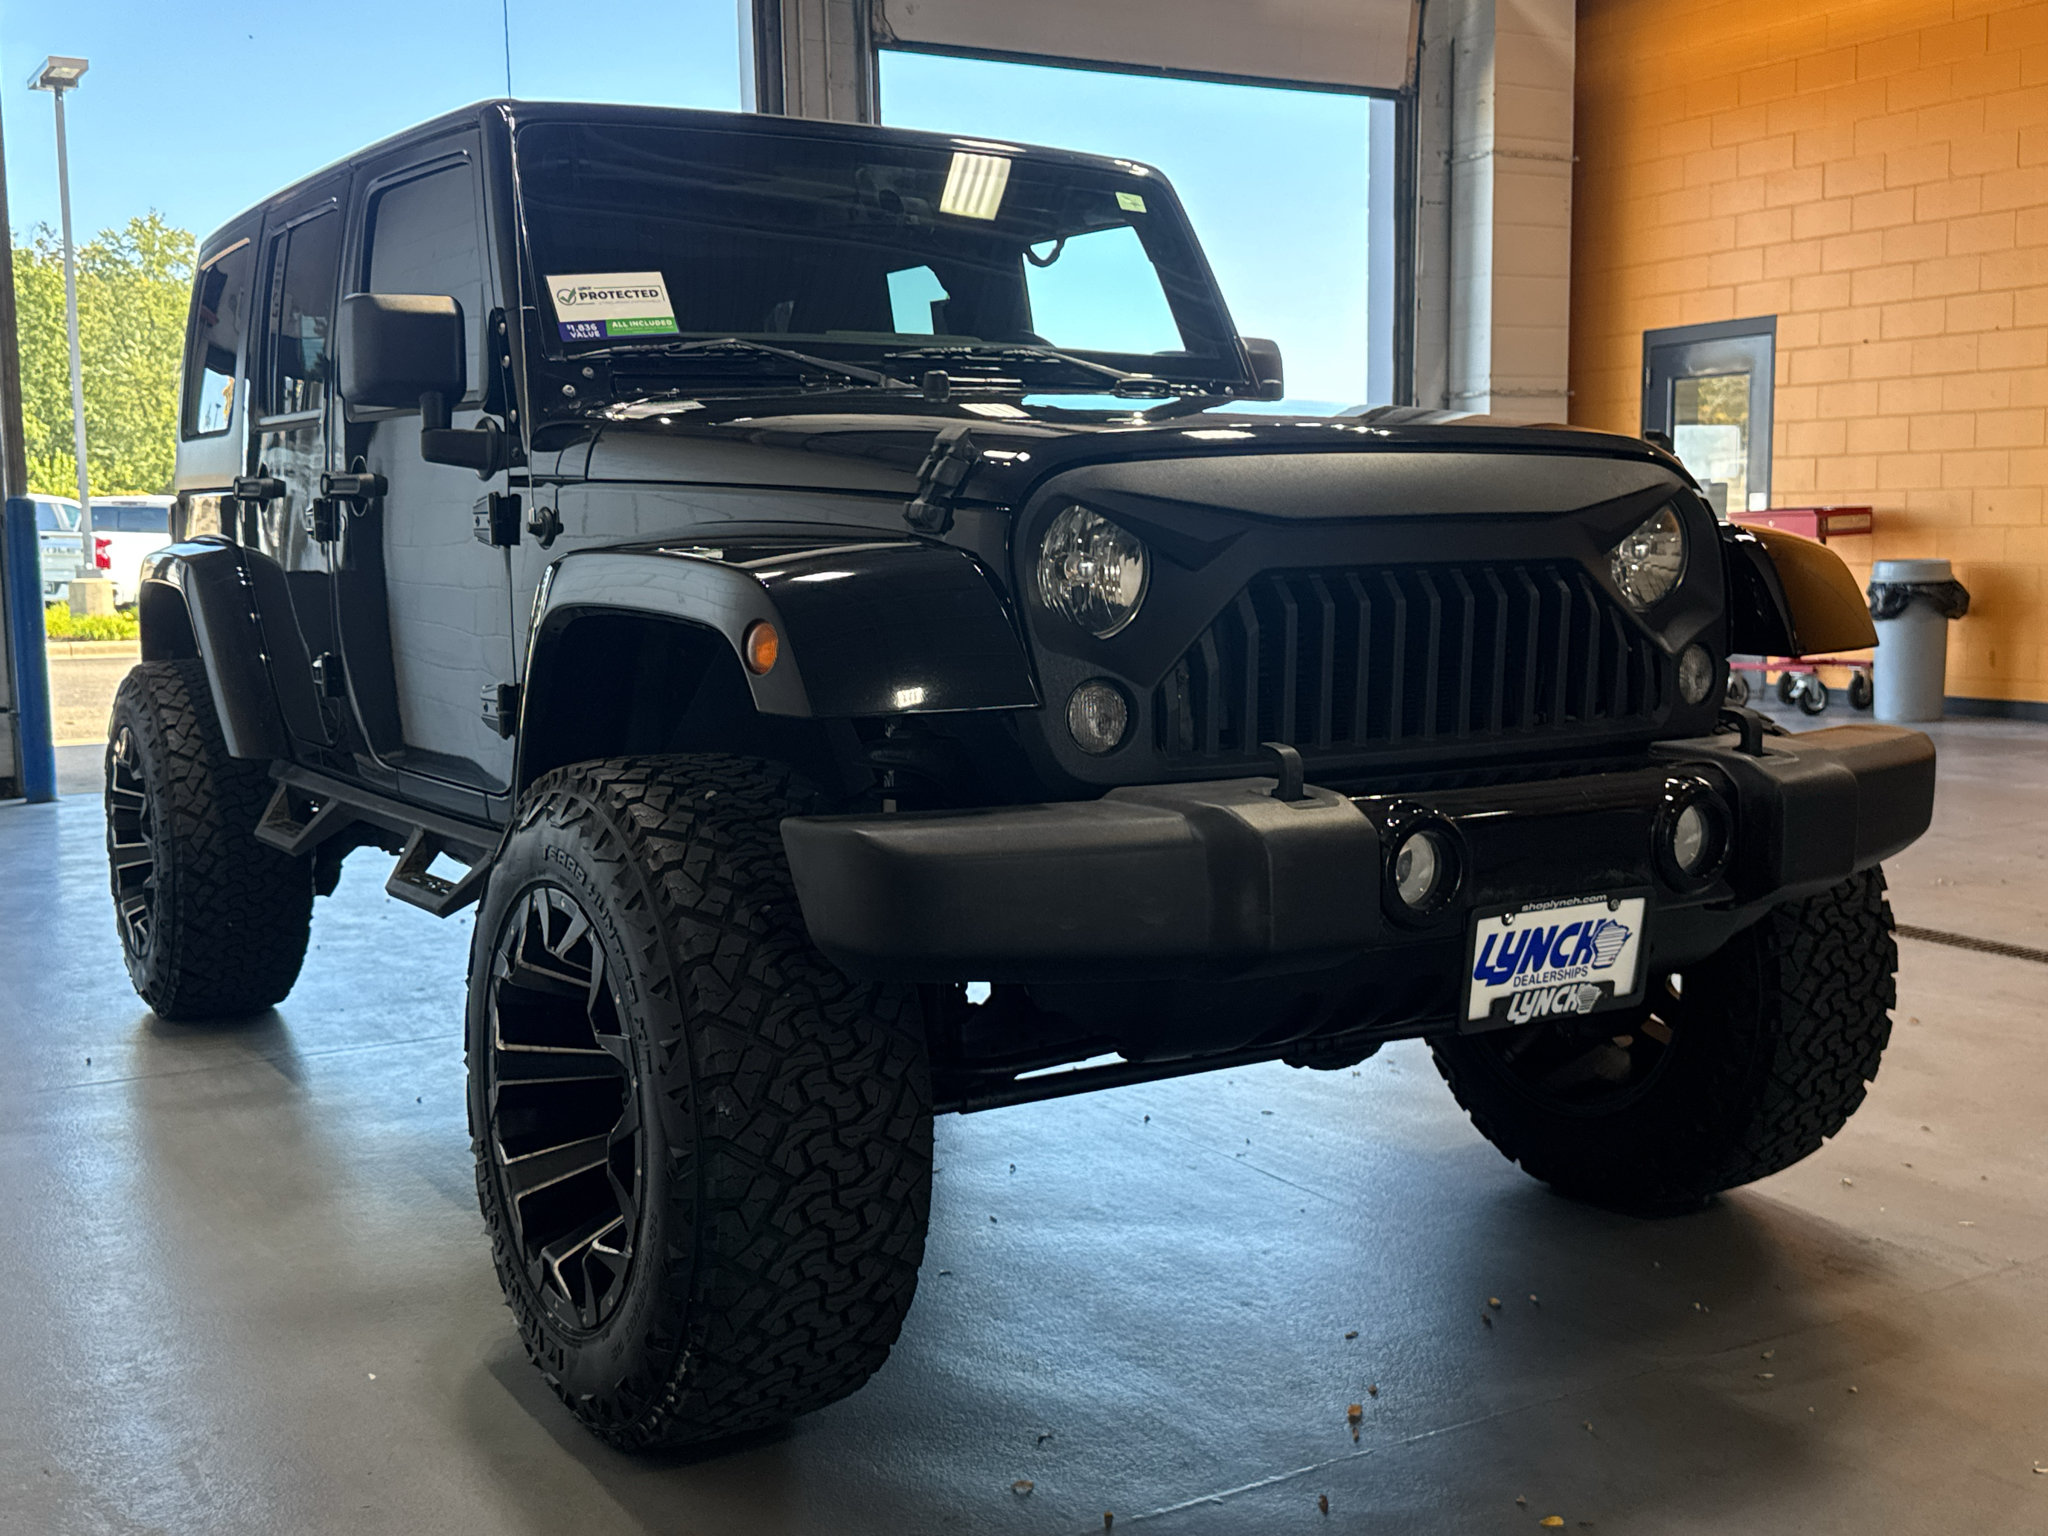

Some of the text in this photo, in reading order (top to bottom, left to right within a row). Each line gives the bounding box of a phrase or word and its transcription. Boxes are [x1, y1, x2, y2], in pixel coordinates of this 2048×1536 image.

[579, 289, 659, 301] PROTECTED
[629, 319, 673, 327] INCLUDED
[569, 330, 600, 339] VALUE
[1521, 893, 1607, 912] shoplynch.com
[1473, 918, 1607, 987] LYNCH
[1513, 965, 1588, 988] DEALERSHIPS
[1506, 982, 1580, 1024] LYNCH
